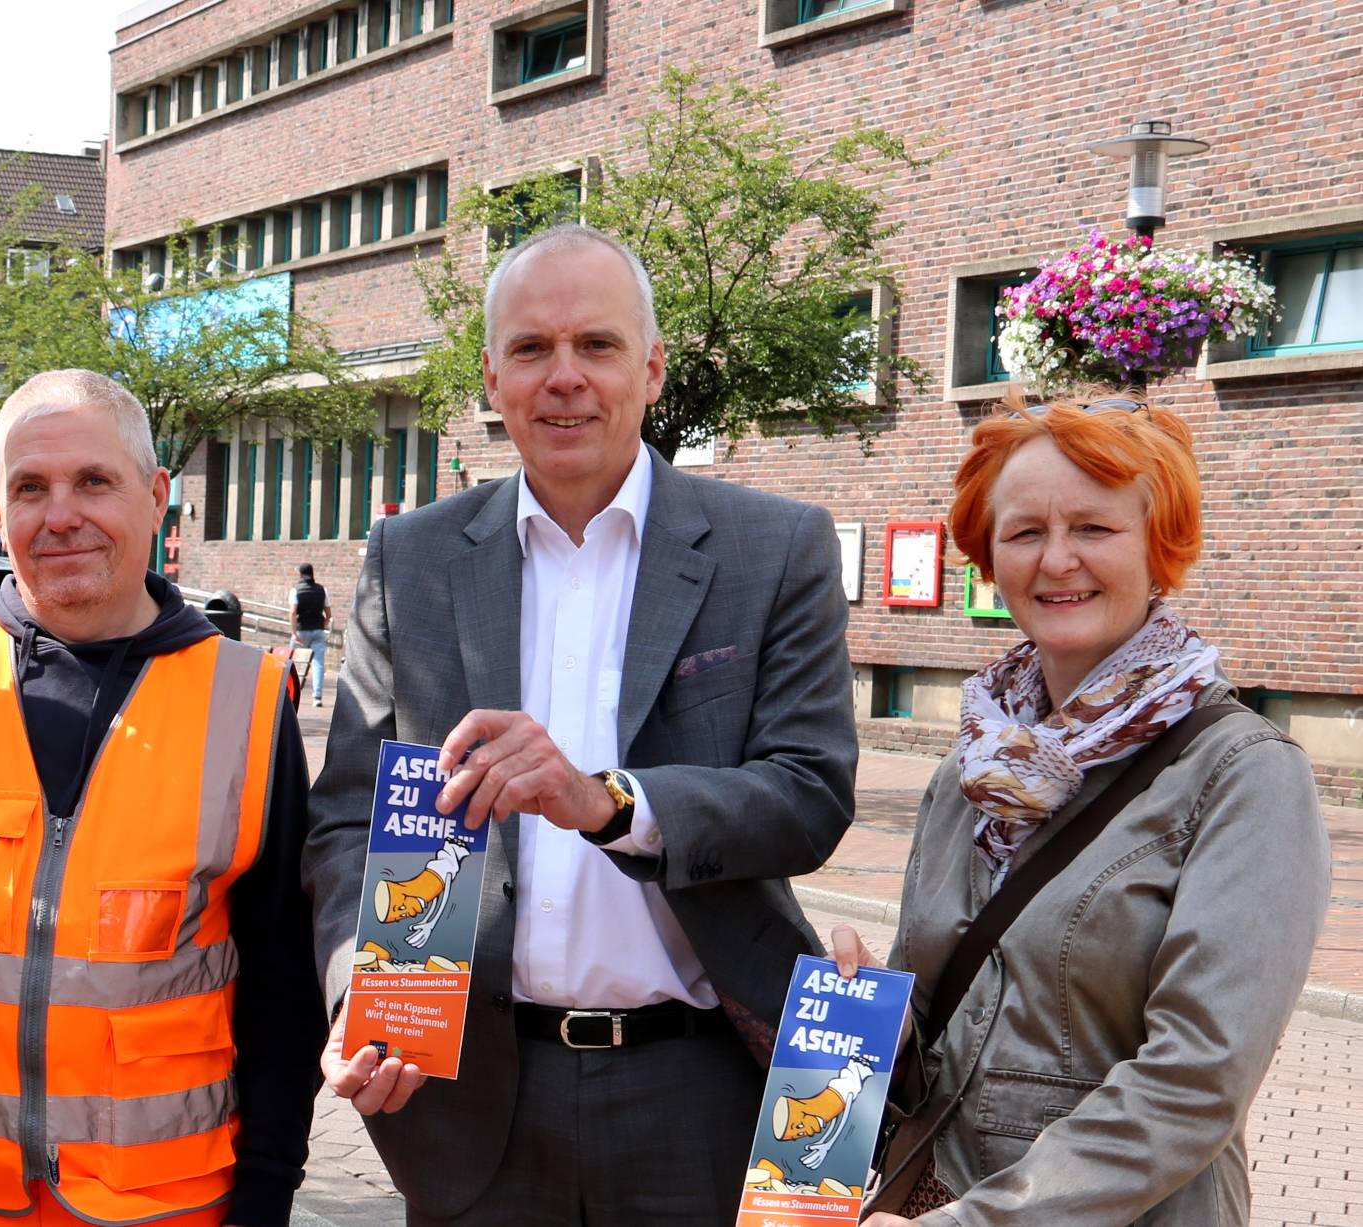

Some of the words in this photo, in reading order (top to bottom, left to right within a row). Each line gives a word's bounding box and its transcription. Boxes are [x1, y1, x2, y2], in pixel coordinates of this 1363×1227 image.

[391, 756, 452, 782] ASCH
[387, 784, 419, 807] ZU
[361, 978, 388, 987] #Essen
[400, 977, 458, 987] Stummelchen
[802, 969, 878, 1001] ASCHE
[374, 998, 387, 1008] Sei
[388, 1000, 402, 1010] ein
[404, 1002, 441, 1016] Kippster!
[795, 997, 830, 1023] ZU
[365, 1008, 384, 1018] Wirf
[384, 1011, 408, 1022] deine
[410, 1015, 447, 1029] Stummel
[386, 1024, 403, 1034] hier
[404, 1027, 424, 1037] rein!
[790, 1198, 849, 1213] Stummelchen
